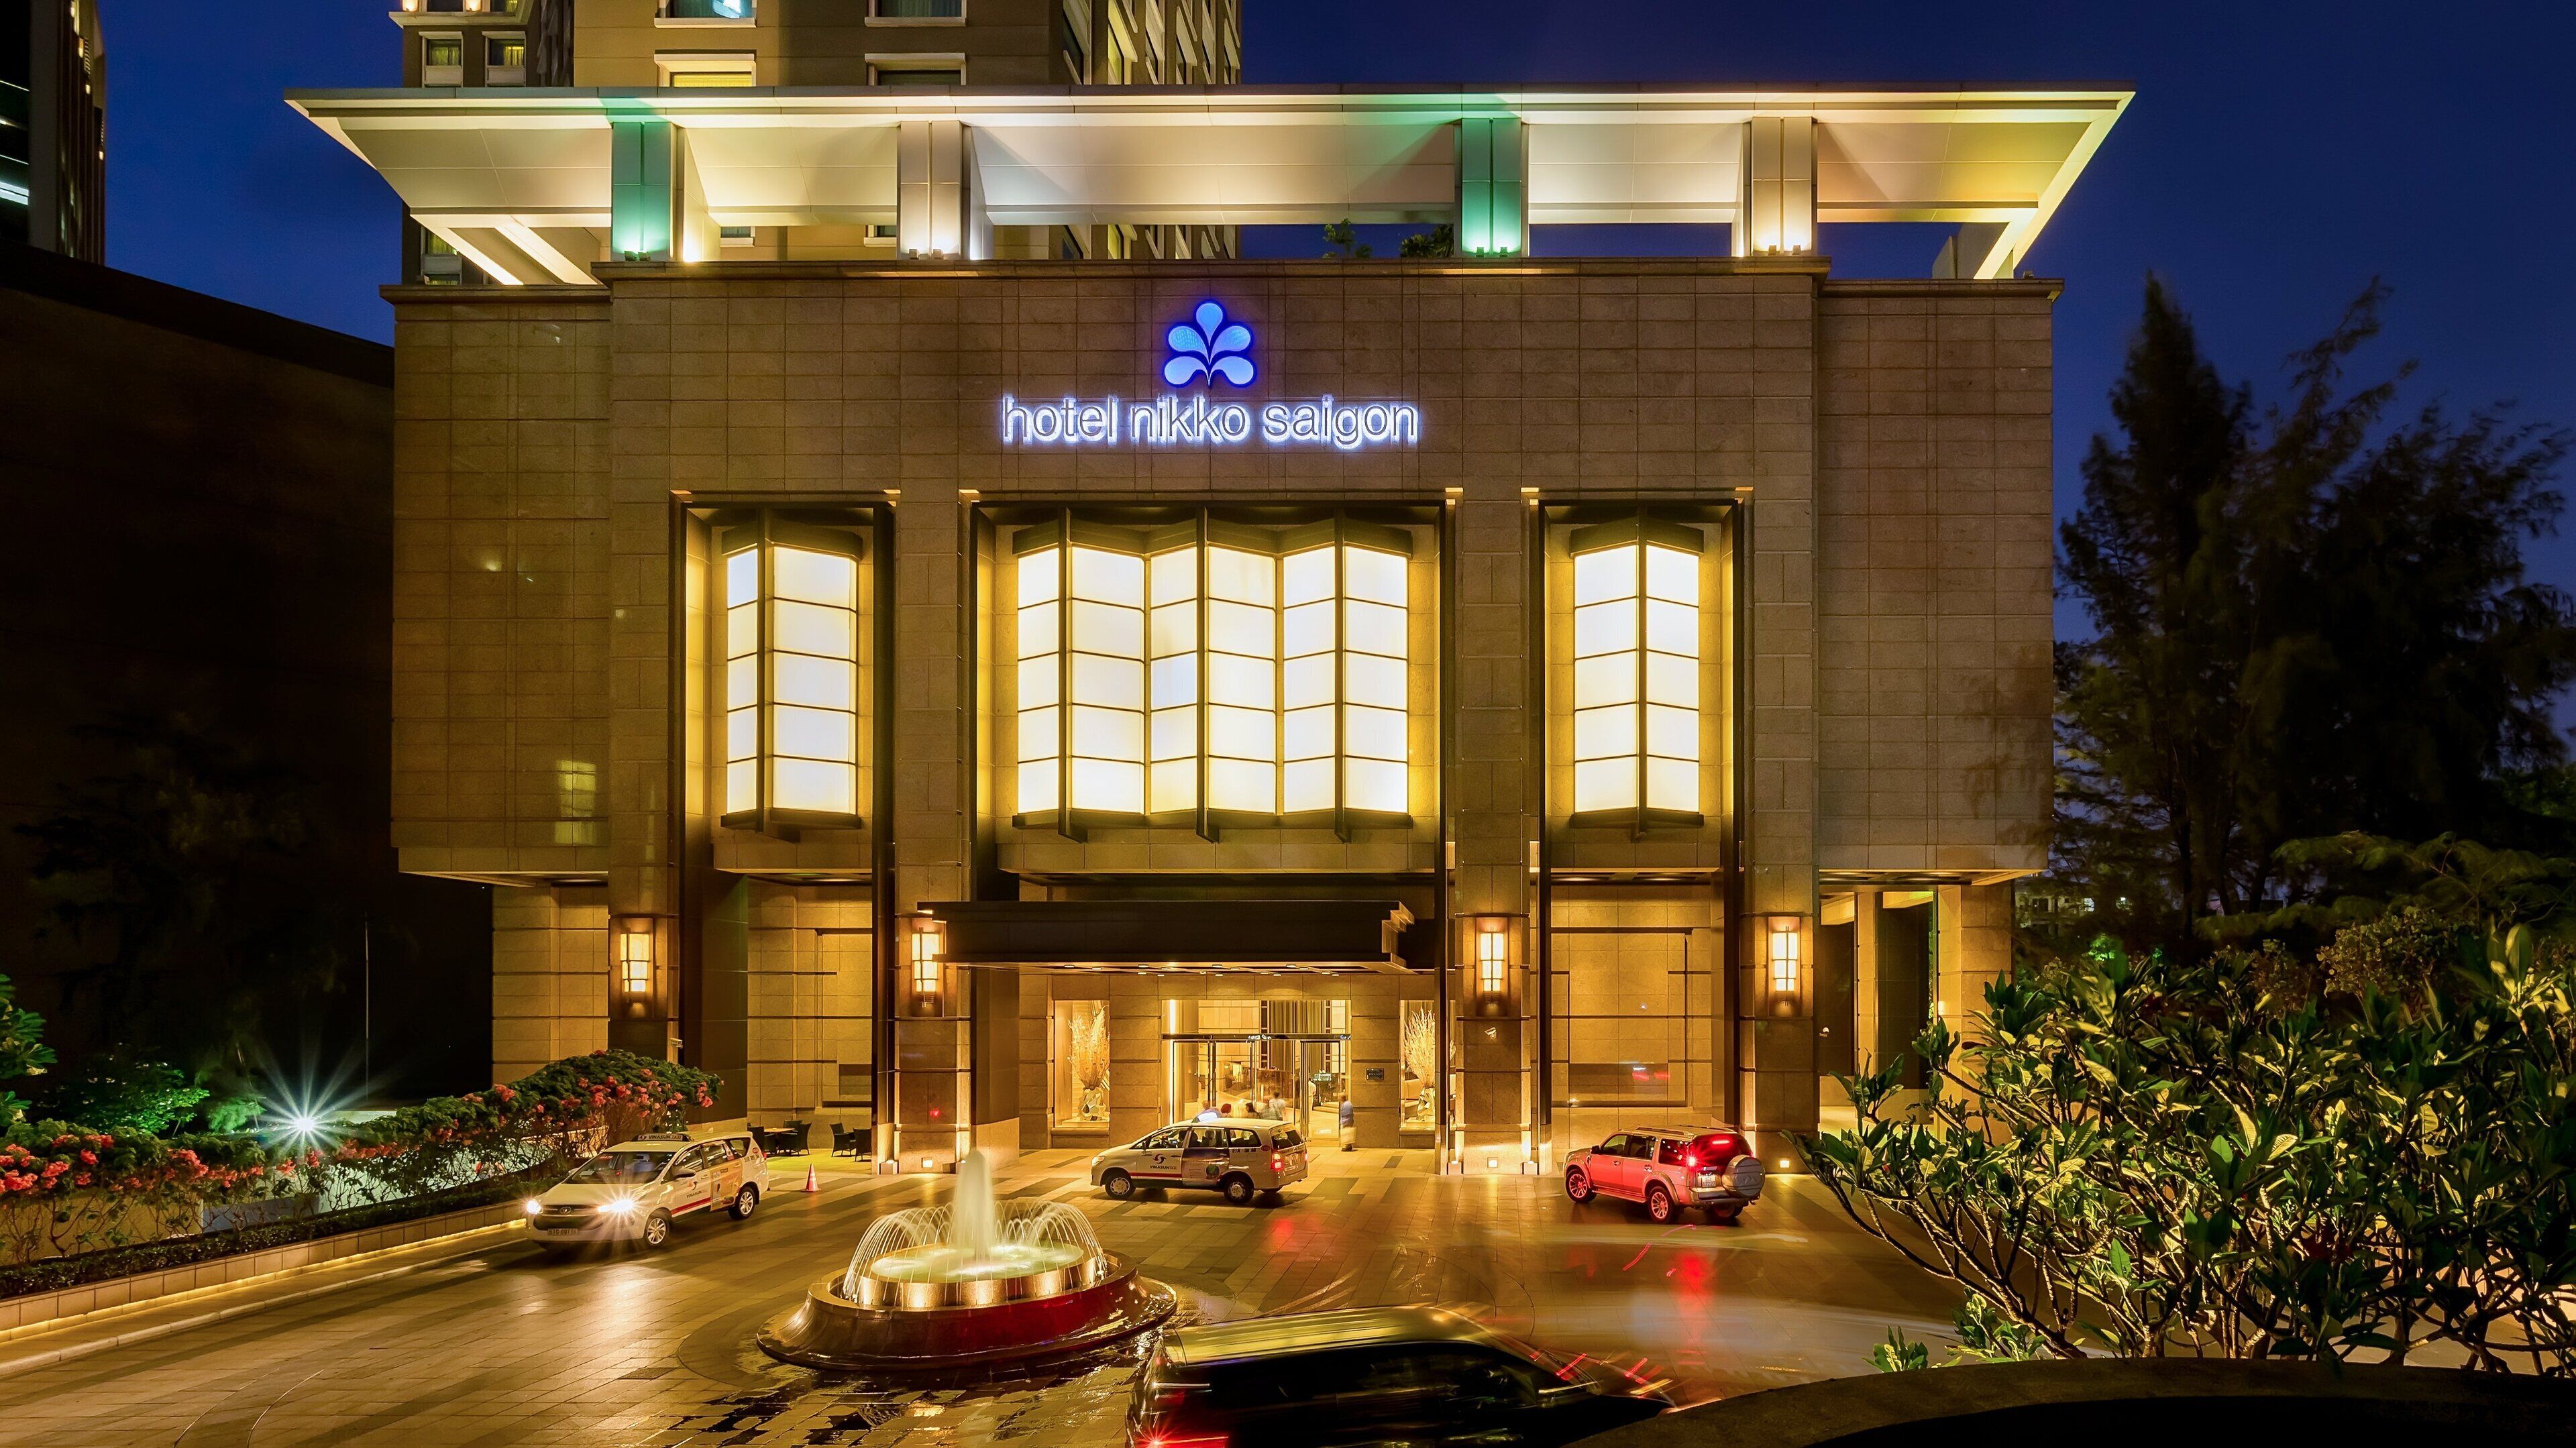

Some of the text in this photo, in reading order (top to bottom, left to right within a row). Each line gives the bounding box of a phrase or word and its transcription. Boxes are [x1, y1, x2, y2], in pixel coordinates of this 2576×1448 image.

[1003, 394, 1417, 447] hotel nikko saigon
